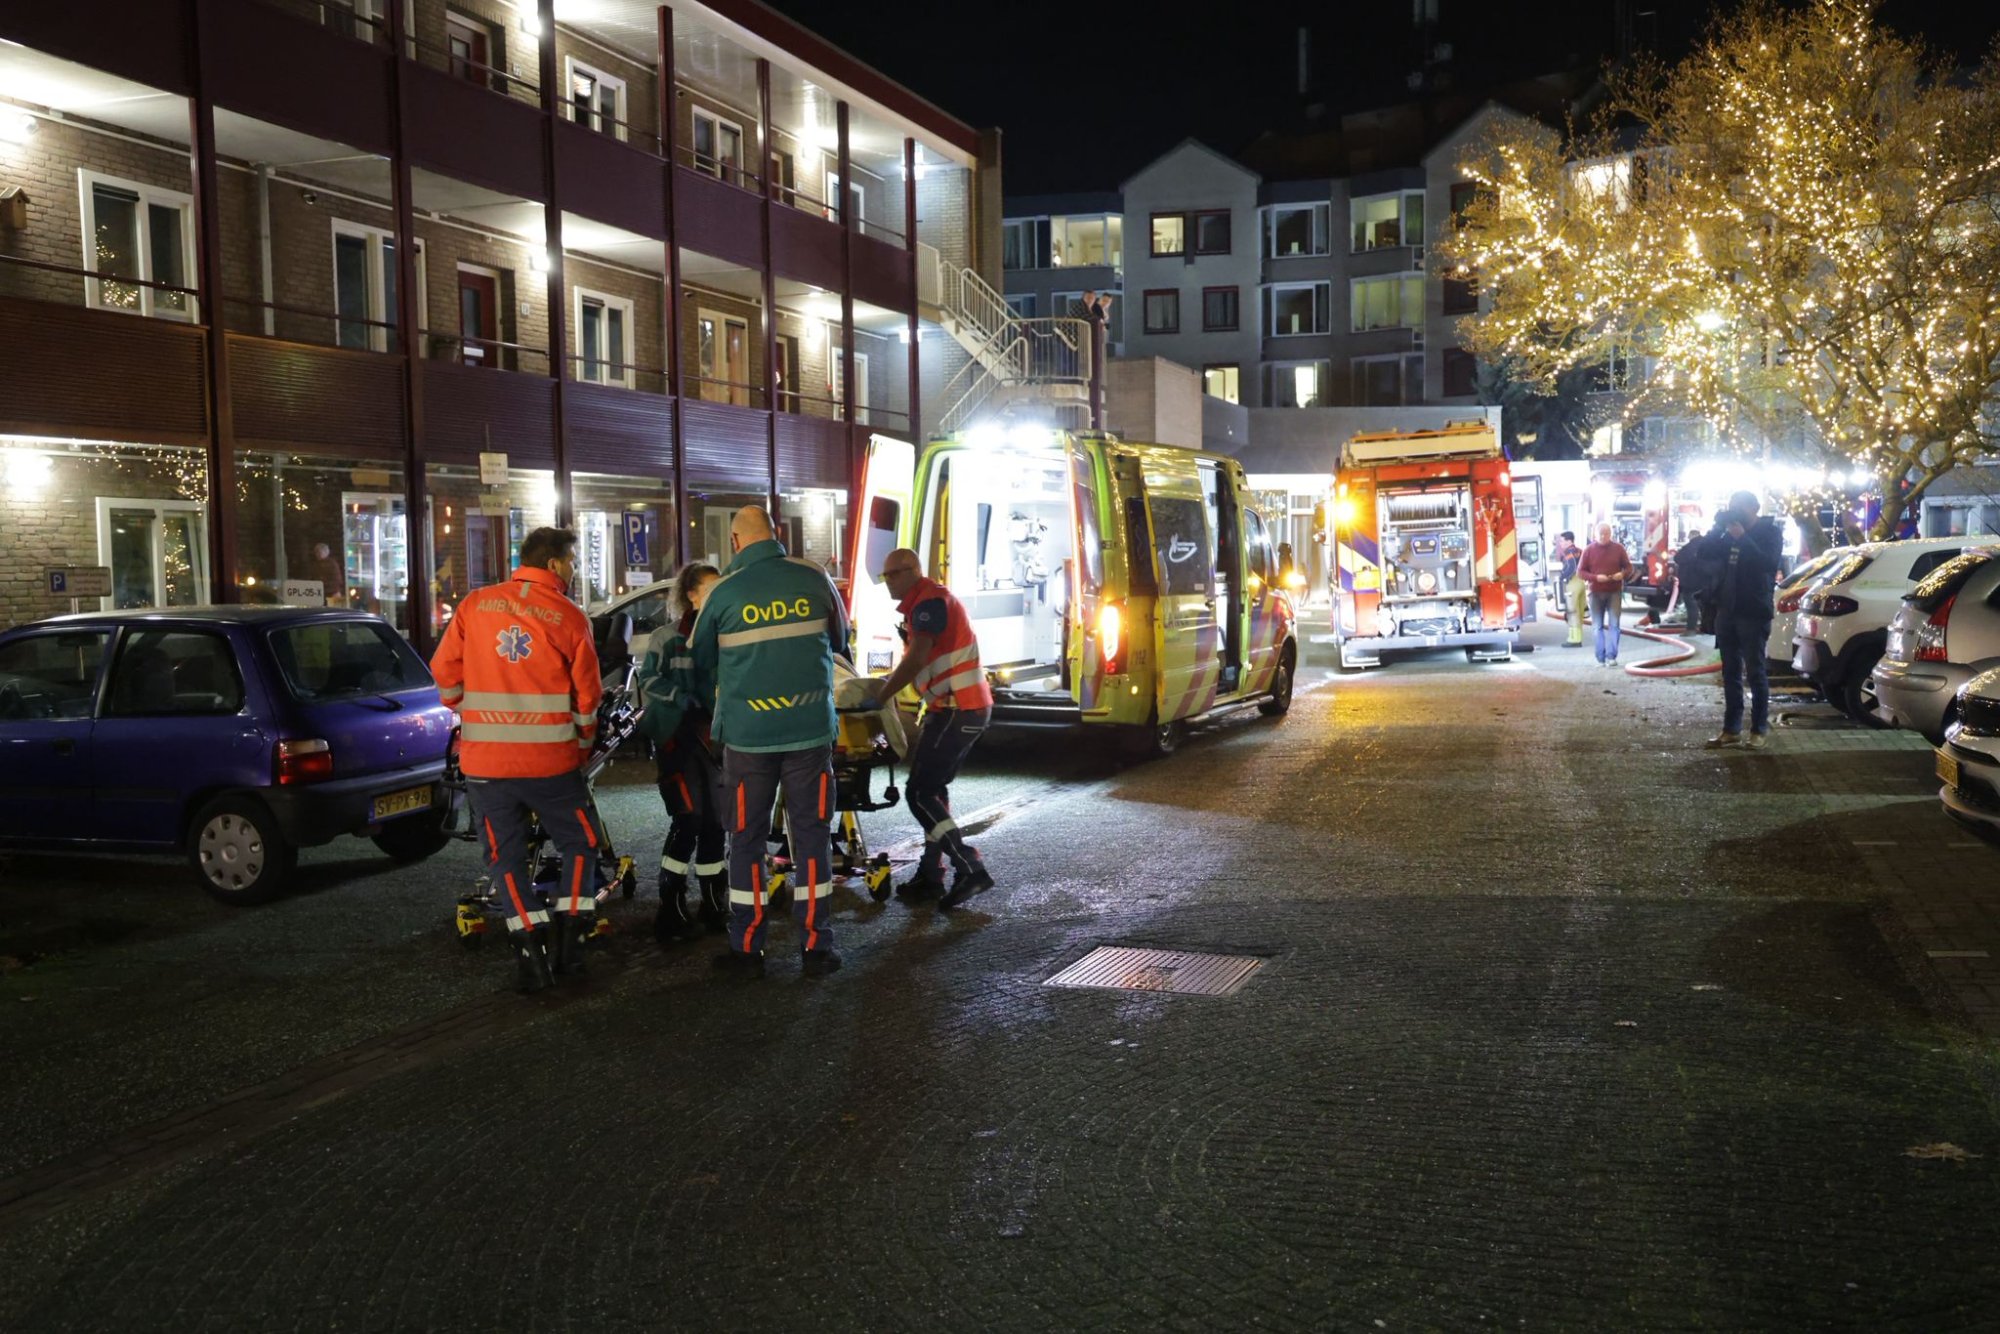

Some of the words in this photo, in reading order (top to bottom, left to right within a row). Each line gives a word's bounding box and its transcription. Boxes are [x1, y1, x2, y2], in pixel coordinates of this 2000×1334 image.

[628, 515, 642, 543] P
[53, 574, 62, 590] P
[477, 598, 563, 626] AMBULANCE
[742, 598, 810, 624] OvD-G
